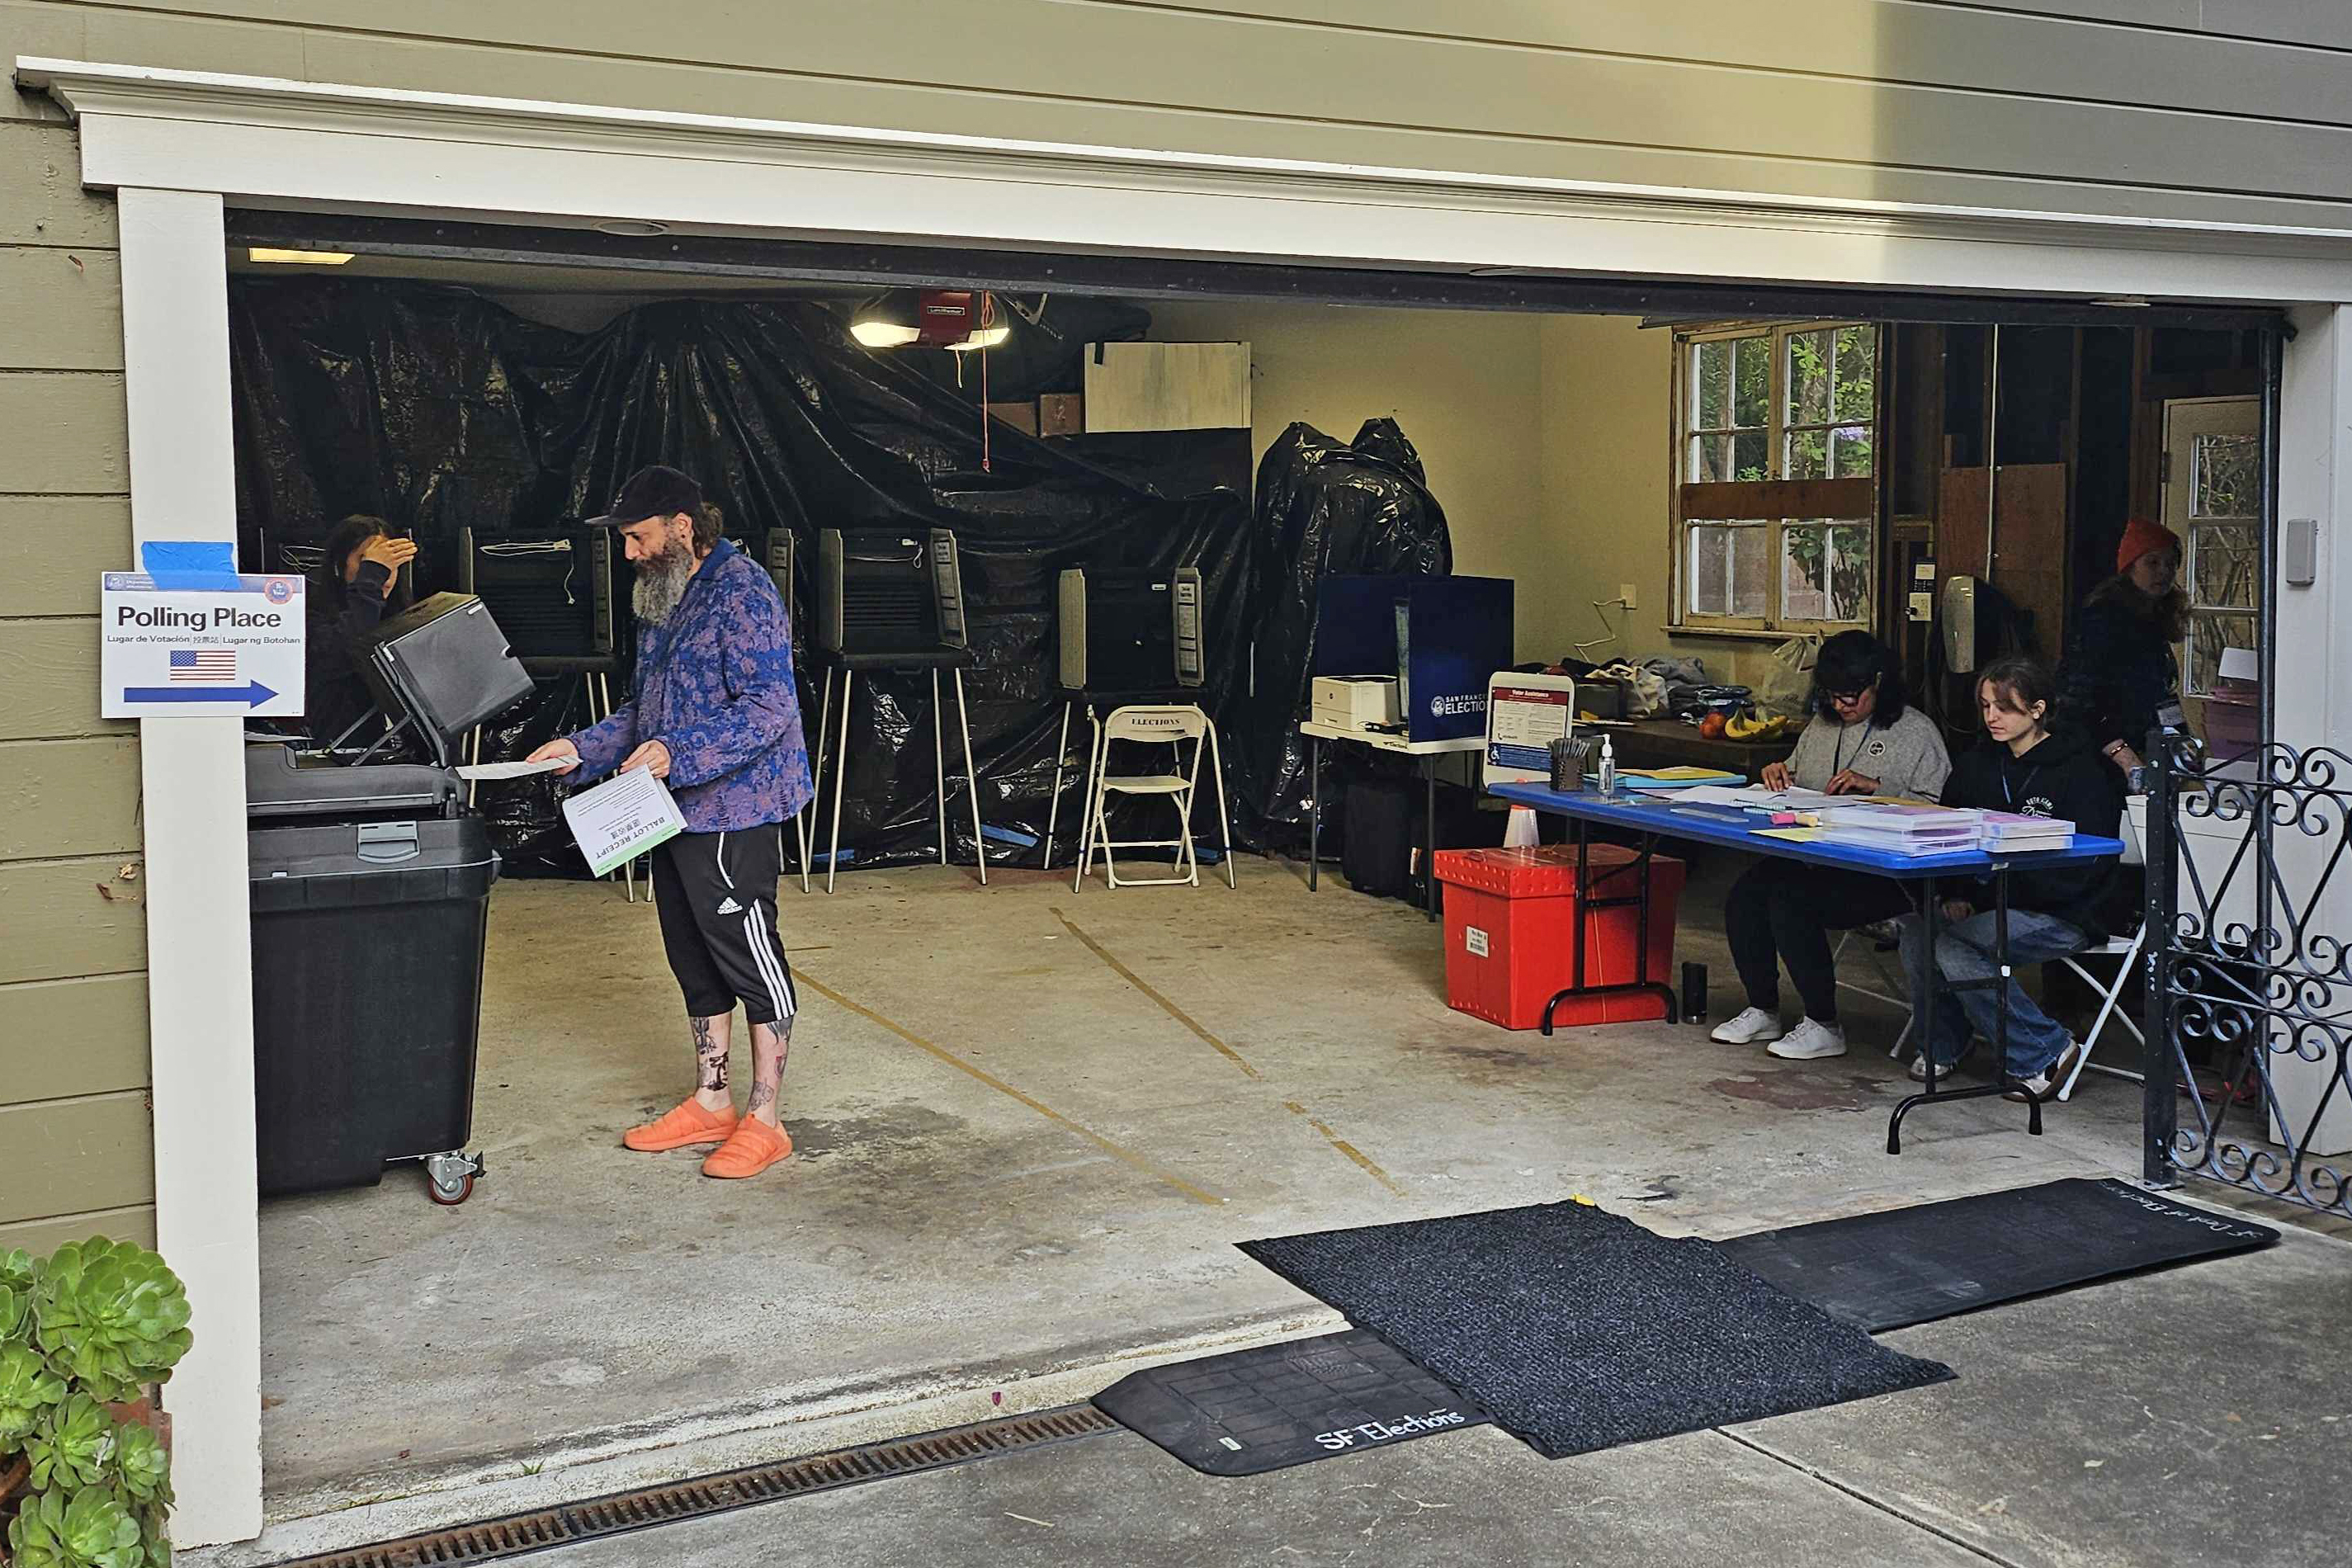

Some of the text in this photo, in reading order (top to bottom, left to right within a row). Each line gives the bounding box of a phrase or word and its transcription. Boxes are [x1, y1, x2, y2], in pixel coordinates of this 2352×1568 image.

[118, 606, 281, 631] Polling Place
[107, 635, 134, 645] Lugar
[149, 635, 190, 643] Votación
[223, 636, 248, 645] Lugar
[263, 636, 300, 645] Botohan
[1445, 700, 1488, 715] ELECTIO
[633, 816, 666, 840] BALLOT
[596, 836, 631, 859] RECEIPT
[1315, 1407, 1466, 1451] SF Elections
